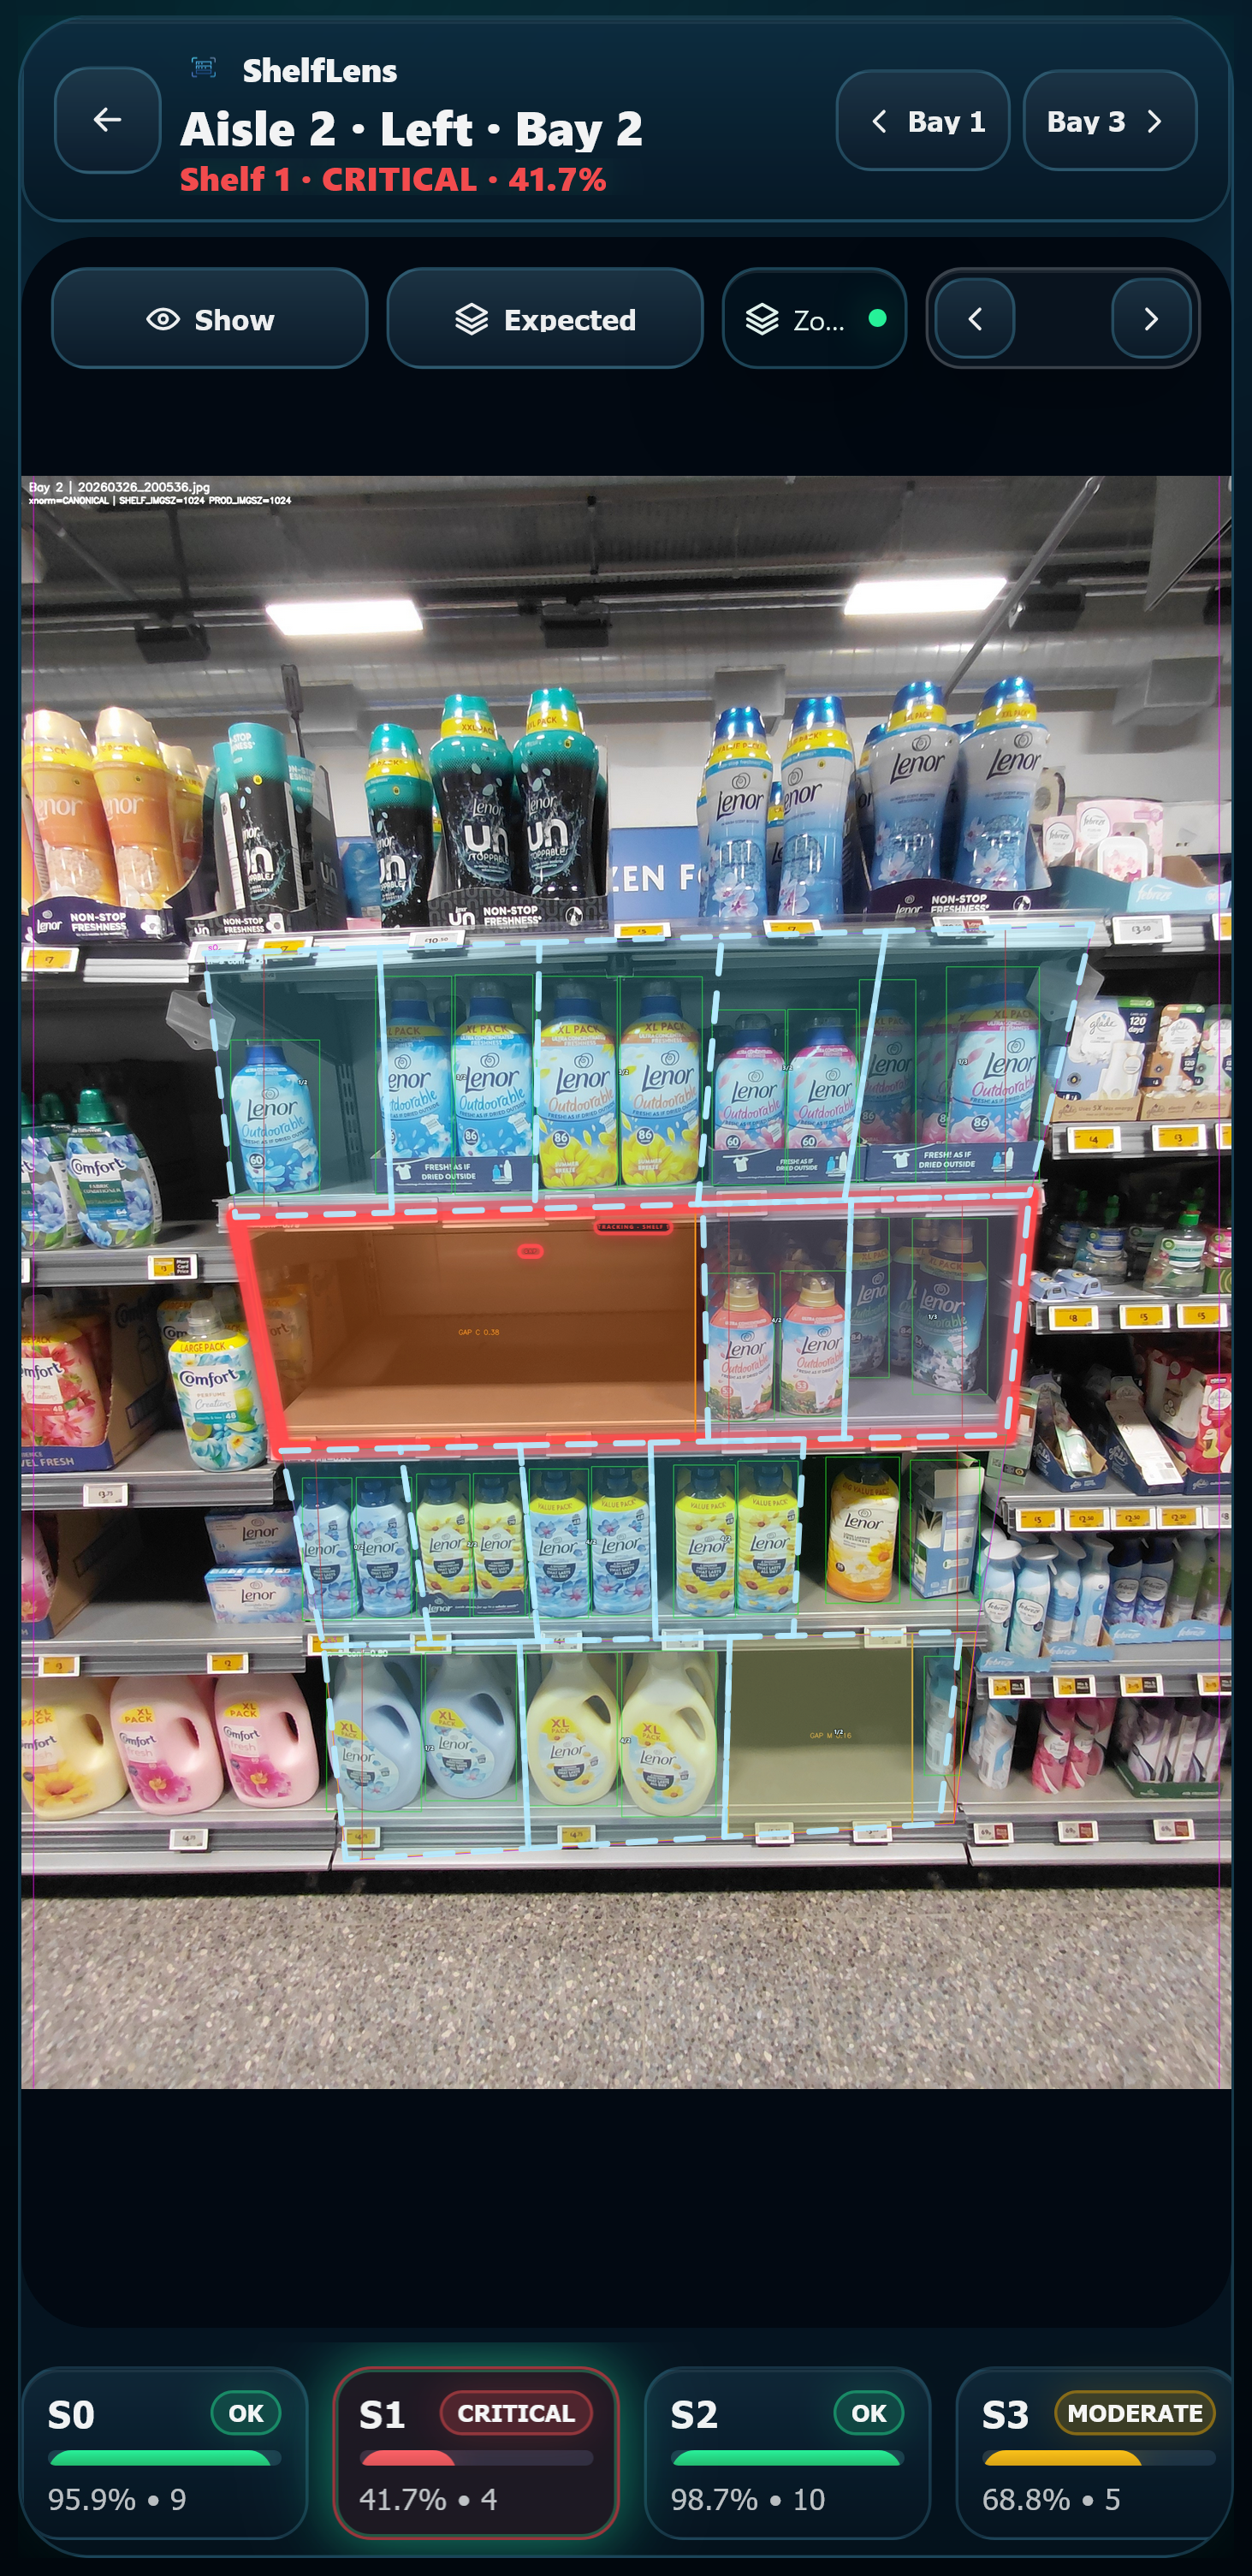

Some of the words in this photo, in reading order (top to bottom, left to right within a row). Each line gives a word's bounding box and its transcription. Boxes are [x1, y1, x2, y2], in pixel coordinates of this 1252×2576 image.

[244, 57, 397, 82] ShelfLens
[180, 110, 294, 146] Aisle
[311, 111, 335, 145] 2
[383, 110, 472, 146] Left
[518, 112, 602, 152] Bay
[617, 111, 642, 145] 2
[910, 111, 961, 134] Bay
[971, 111, 985, 132] 1
[1048, 111, 1100, 134] Bay
[1109, 111, 1125, 132] 3
[181, 166, 264, 191] Shelf
[276, 168, 288, 191] 1
[323, 168, 477, 191] CRITICAL
[509, 168, 606, 191] 41.7%
[196, 309, 275, 330] Show
[506, 309, 635, 332] Expected
[891, 753, 946, 785] Lenor
[986, 748, 1041, 781] Lenor
[472, 798, 504, 817] Lenor
[527, 795, 558, 816] Lenor
[716, 791, 764, 822] Lenor
[931, 894, 988, 905] NON-STOP
[70, 913, 127, 922] NON-STOP
[484, 905, 538, 916] NON-STOP
[72, 923, 127, 932] FRESHNESS
[466, 1024, 478, 1034] XL
[480, 1024, 507, 1034] PACK
[558, 1025, 570, 1034] XL
[572, 1024, 599, 1034] PACK
[644, 1023, 658, 1031] XL
[659, 1023, 685, 1031] PACK
[1130, 1017, 1147, 1025] 120
[394, 1027, 420, 1036] PACK
[982, 1052, 1035, 1080] Lenor
[466, 1066, 519, 1094] Lenor
[556, 1067, 610, 1095] Lenor
[642, 1065, 694, 1094] Lenor
[972, 1074, 1035, 1097] Outdoorable
[460, 1087, 525, 1111] Outdoorable
[549, 1087, 614, 1113] Outdoorable
[633, 1084, 697, 1111] Outdoorable
[731, 1081, 778, 1104] Lenor
[808, 1079, 852, 1104] Lenor
[247, 1099, 298, 1121] Lenor
[723, 1098, 780, 1119] Outdoorable
[799, 1098, 854, 1119] Outdoorable
[242, 1115, 306, 1138] Outdoorable
[973, 1118, 988, 1127] 86
[465, 1131, 478, 1141] 86
[555, 1134, 568, 1143] 86
[638, 1131, 652, 1140] 86
[727, 1137, 739, 1146] 60
[803, 1137, 815, 1146] 60
[71, 1157, 127, 1181] Comfort
[251, 1155, 263, 1166] 60
[920, 1291, 965, 1314] Lenor
[181, 1344, 204, 1353] LARGE
[205, 1342, 226, 1351] PACK
[726, 1340, 767, 1360] Lenor
[801, 1336, 842, 1355] Lenor
[180, 1368, 238, 1388] Comfort
[40, 1457, 74, 1467] FRESH
[537, 1503, 555, 1511] VALUE
[845, 1512, 884, 1530] Lenor
[242, 1526, 278, 1541] Lenor
[430, 1538, 465, 1553] Lenor
[480, 1536, 516, 1552] Lenor
[539, 1540, 578, 1556] Lenor
[602, 1538, 641, 1554] Lenor
[751, 1535, 790, 1552] Lenor
[240, 1589, 276, 1604] Lenor
[125, 1714, 154, 1724] PACK
[137, 1708, 151, 1717] XL
[230, 1709, 258, 1718] PACK
[439, 1710, 456, 1721] XL
[340, 1722, 357, 1733] XL
[551, 1718, 569, 1728] XL
[643, 1724, 661, 1735] XL
[119, 1732, 157, 1748] Comfort
[223, 1726, 260, 1742] Comfort
[439, 1736, 472, 1750] Lenor
[343, 1748, 375, 1763] Lenor
[550, 1745, 586, 1759] Lenor
[640, 1750, 677, 1766] Lenor
[49, 2401, 94, 2429] S0
[229, 2405, 264, 2422] OK
[360, 2401, 405, 2429] S1
[459, 2405, 575, 2422] CRITICAL
[672, 2401, 717, 2429] S2
[852, 2405, 887, 2422] OK
[983, 2401, 1028, 2429] S3
[1069, 2405, 1202, 2422] MODERATE
[49, 2489, 135, 2510] 95.9%
[171, 2489, 186, 2510] 9
[360, 2489, 446, 2510] 41.7%
[482, 2489, 496, 2510] 4
[672, 2489, 757, 2510] 98.7%
[796, 2489, 824, 2510] 10
[983, 2489, 1070, 2510] 68.8%
[1107, 2489, 1119, 2510] 5
